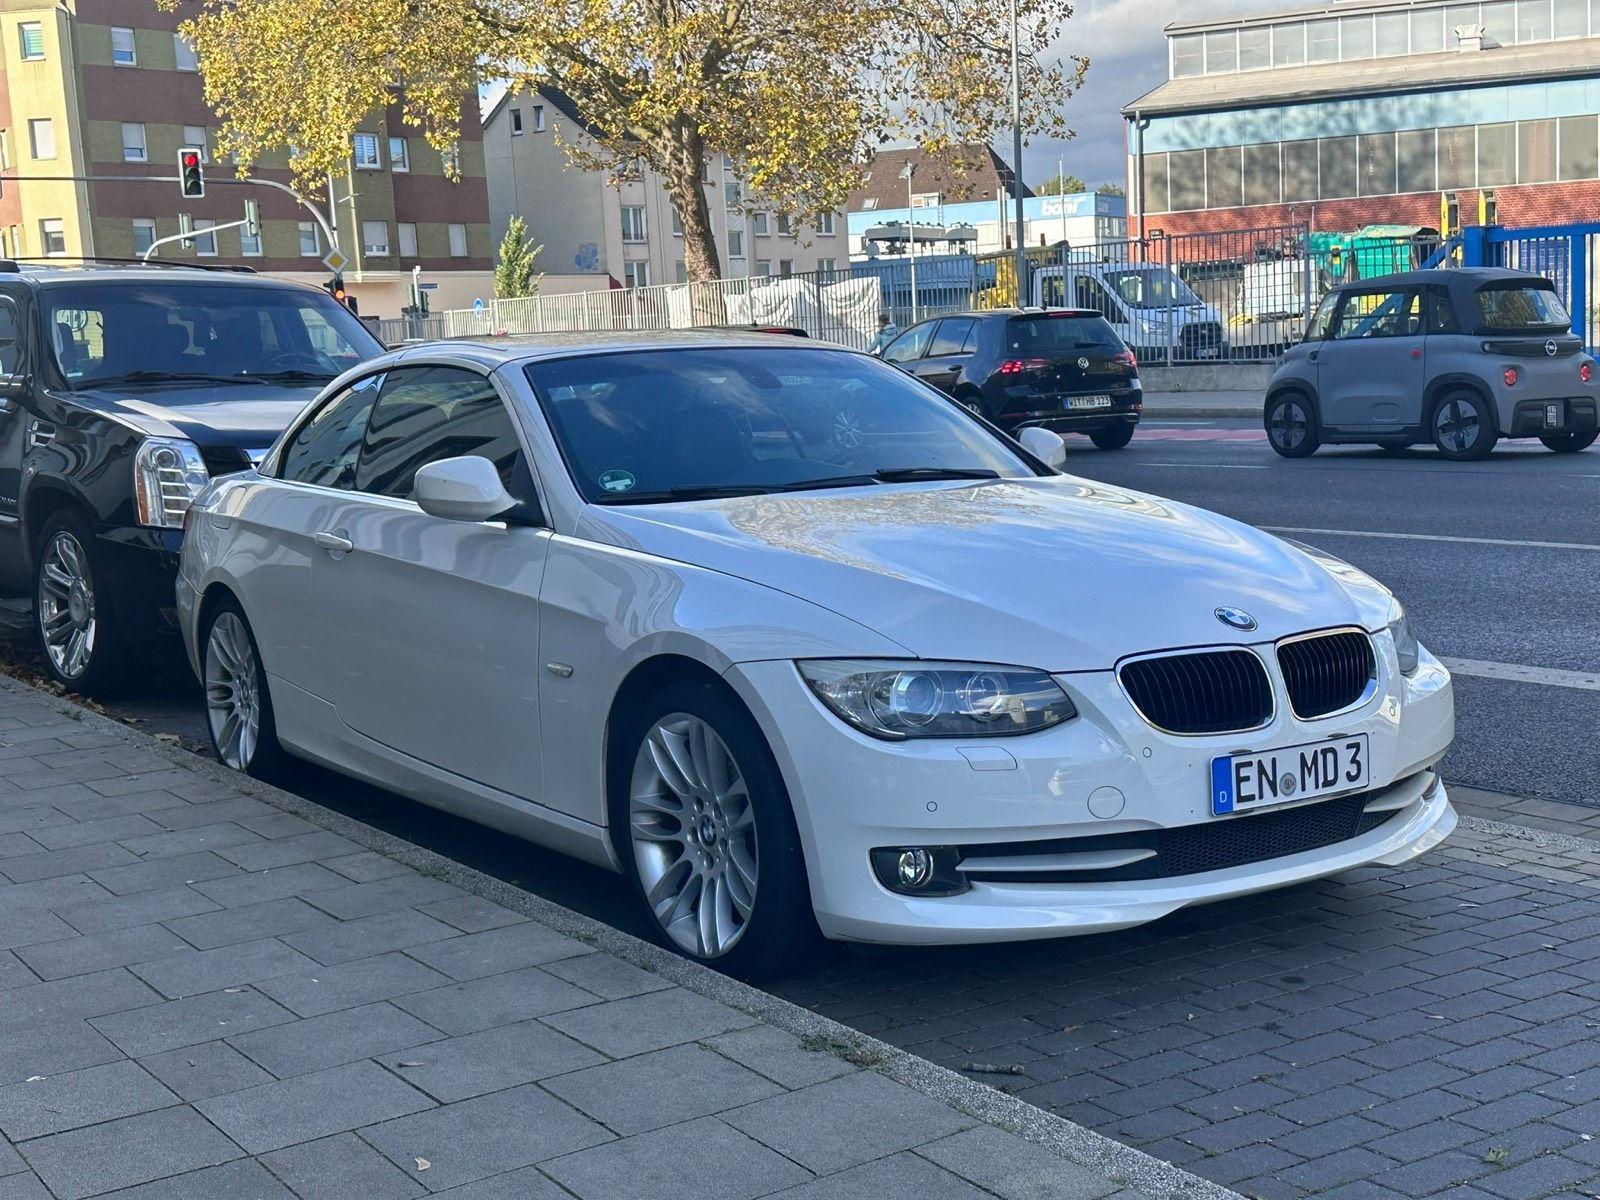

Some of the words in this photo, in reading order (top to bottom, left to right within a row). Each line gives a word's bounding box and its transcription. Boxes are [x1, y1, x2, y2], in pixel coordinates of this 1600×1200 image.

[1235, 757, 1278, 803] EN
[1300, 747, 1339, 792] MD
[1345, 742, 1362, 782] 3
[1219, 791, 1227, 803] D
